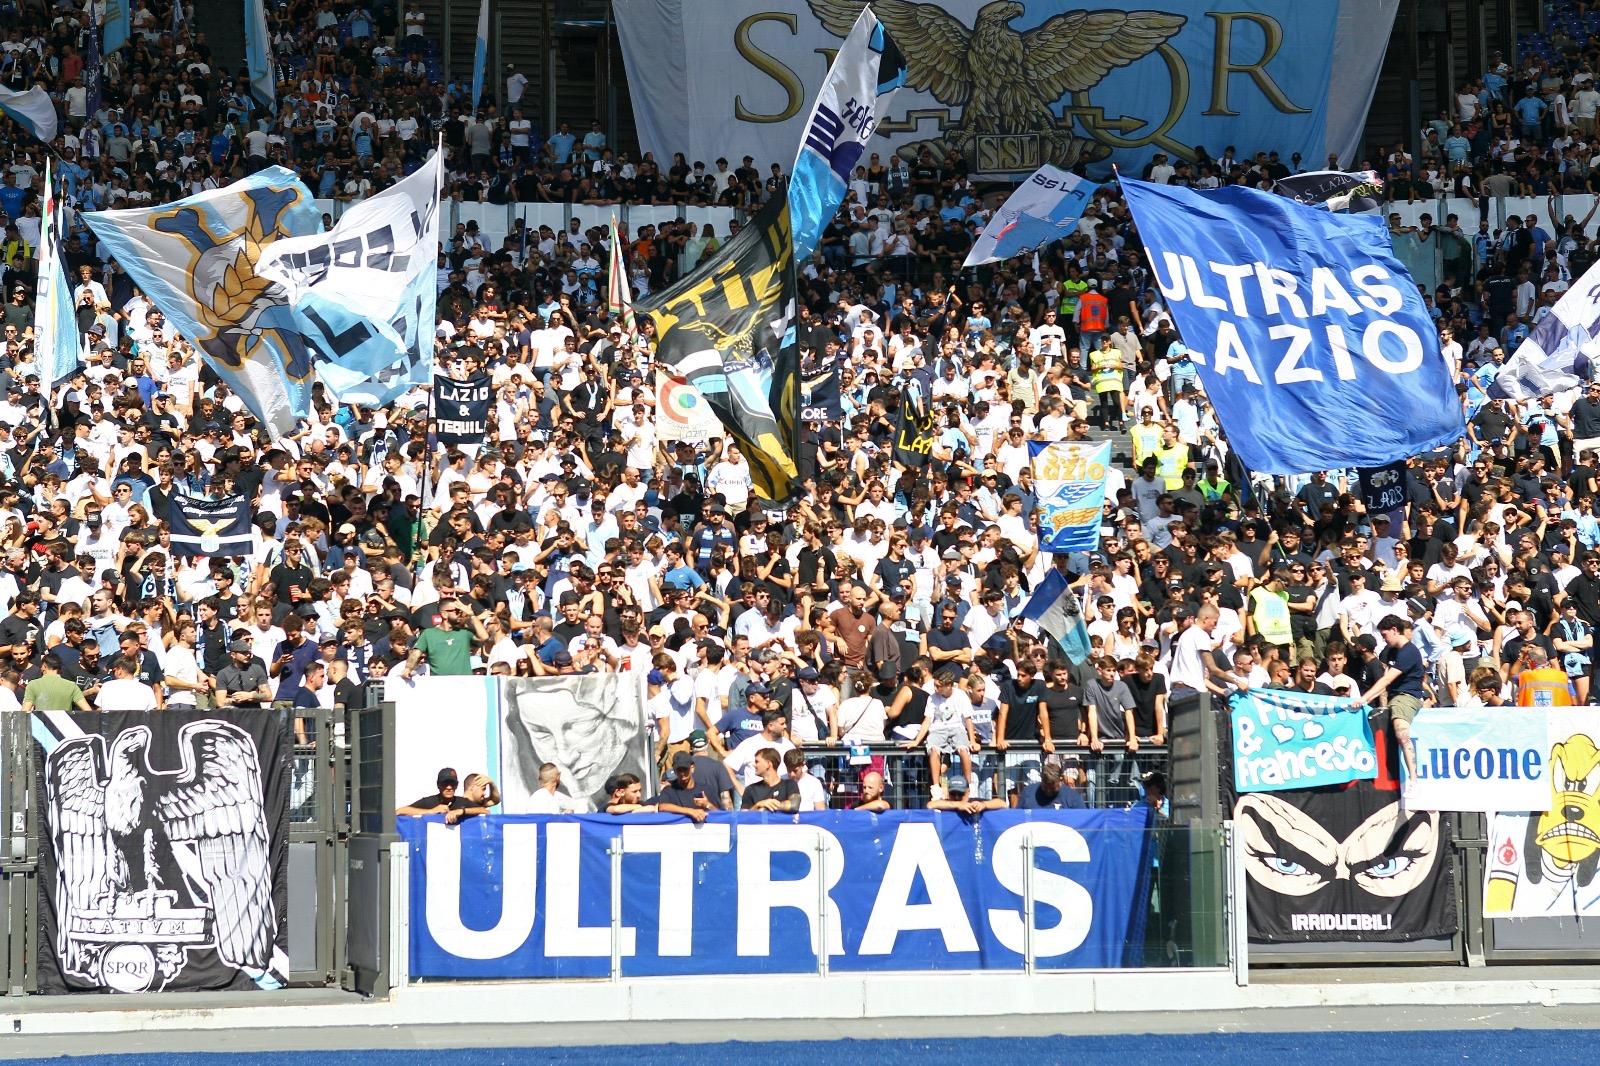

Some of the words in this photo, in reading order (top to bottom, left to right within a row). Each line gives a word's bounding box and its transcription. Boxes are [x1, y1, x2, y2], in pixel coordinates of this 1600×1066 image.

[1145, 247, 1403, 319] ULTRAS
[440, 385, 489, 401] LAZIO
[459, 404, 470, 417] &
[437, 419, 487, 437] TEQUIL
[1236, 716, 1264, 757] &
[1409, 737, 1541, 781] Lucone
[426, 821, 1094, 960] ULTRAS
[1291, 913, 1393, 931] IRRIDUCIBILI
[106, 961, 149, 979] SPQR
